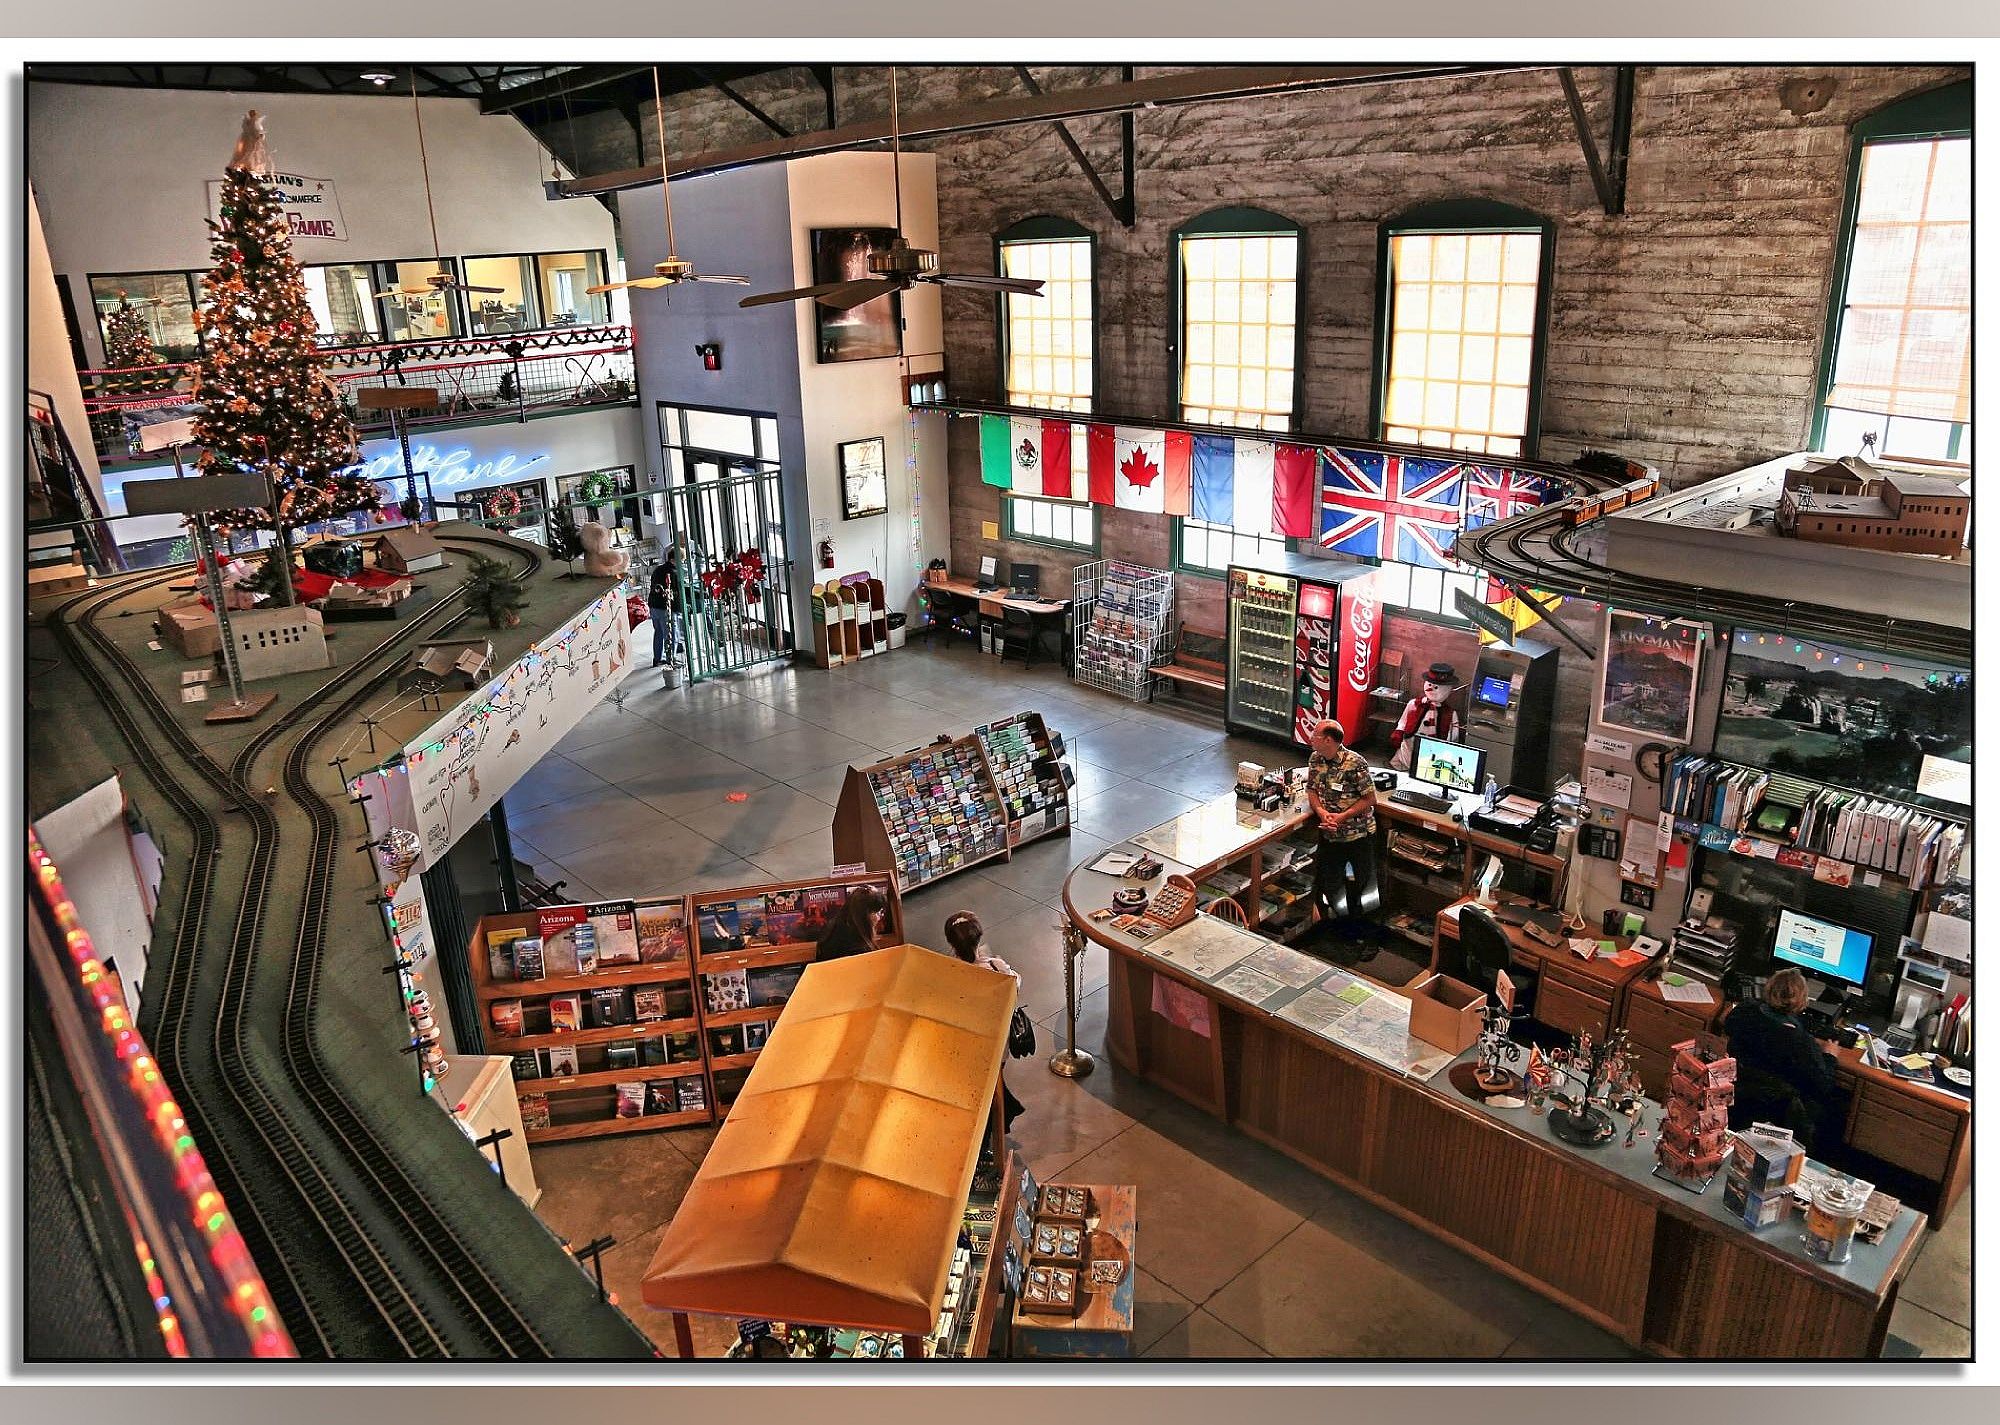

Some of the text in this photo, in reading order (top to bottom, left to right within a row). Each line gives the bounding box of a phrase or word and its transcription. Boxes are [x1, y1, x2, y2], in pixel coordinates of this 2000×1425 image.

[285, 212, 336, 237] FAME
[1619, 630, 1682, 651] KINGMAN
[594, 904, 627, 915] Arizona
[539, 914, 575, 925] Arizona
